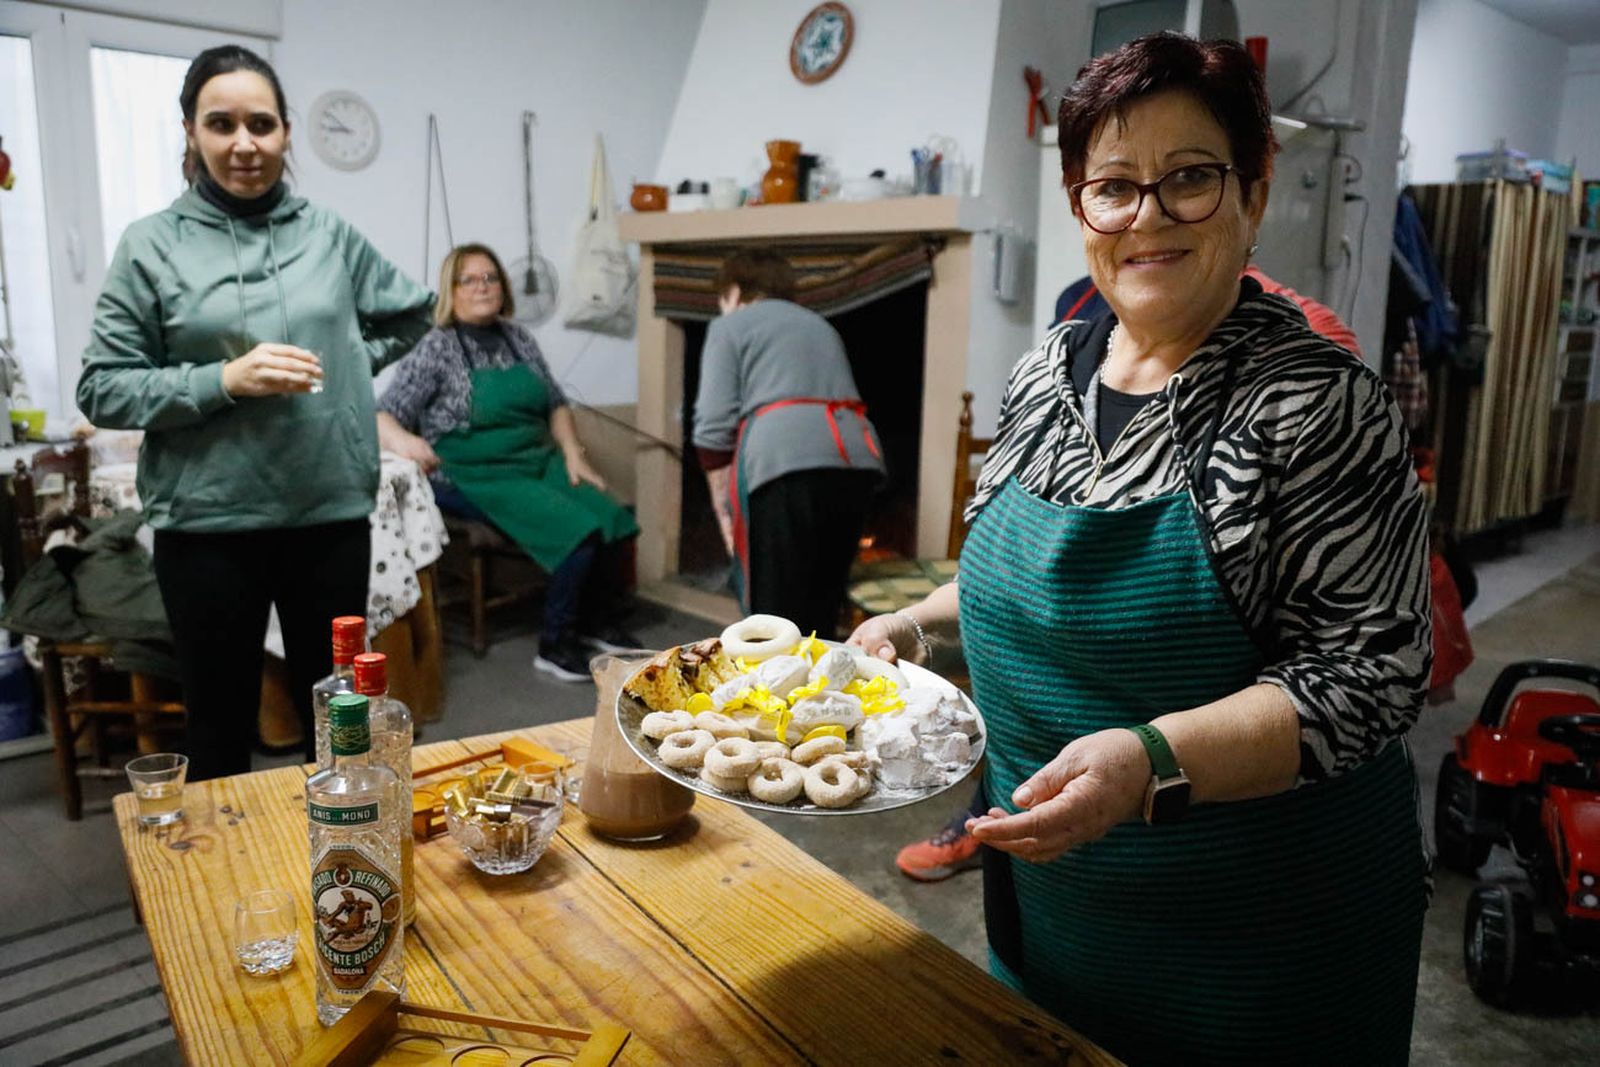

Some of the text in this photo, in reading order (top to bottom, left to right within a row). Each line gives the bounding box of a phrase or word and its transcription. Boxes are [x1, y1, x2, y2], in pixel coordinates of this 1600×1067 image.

[312, 809, 331, 821] ANIS
[342, 809, 371, 821] MONO
[354, 871, 391, 897] REFINADO
[354, 931, 385, 965] BOSCH
